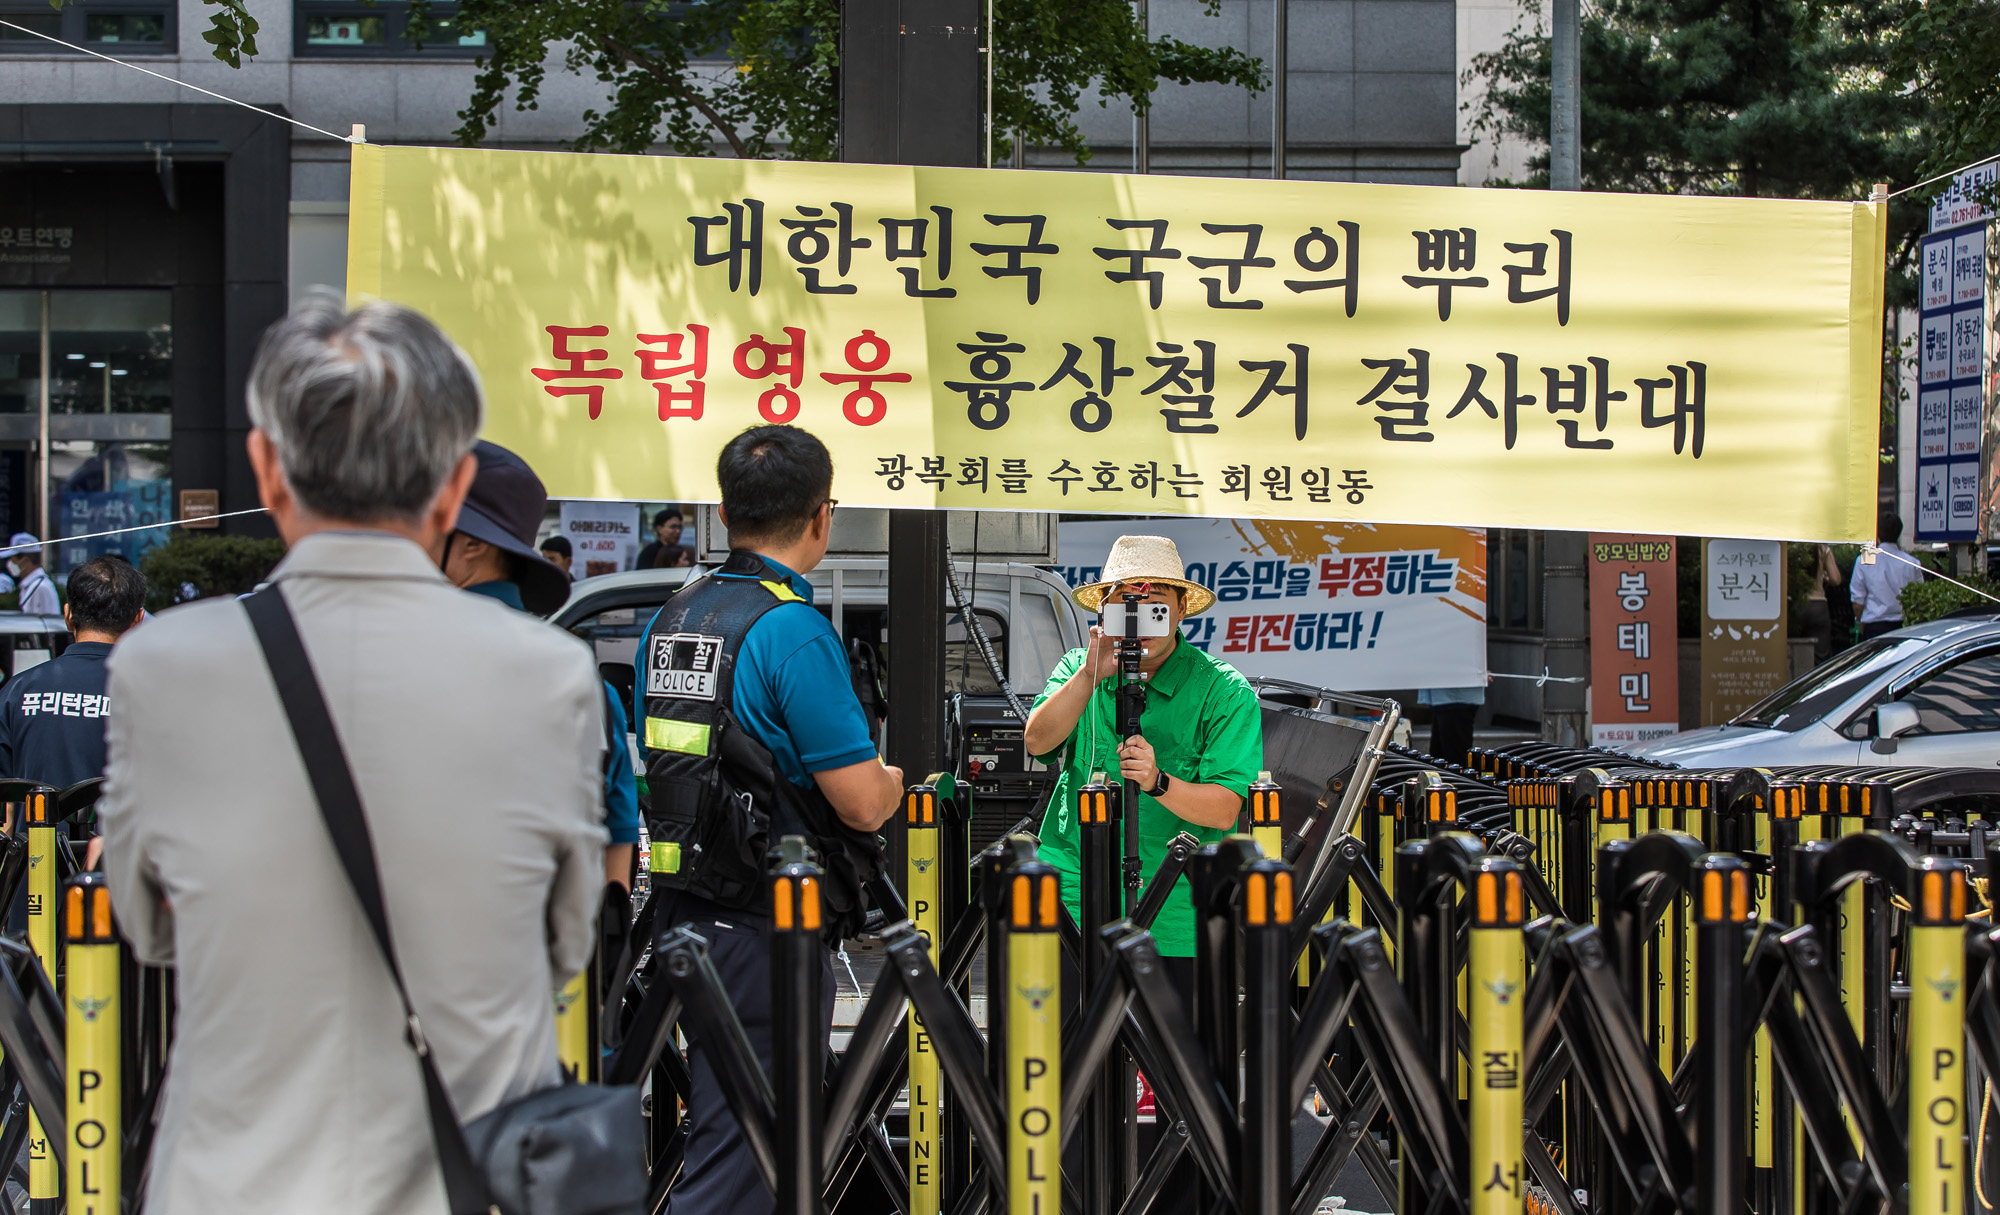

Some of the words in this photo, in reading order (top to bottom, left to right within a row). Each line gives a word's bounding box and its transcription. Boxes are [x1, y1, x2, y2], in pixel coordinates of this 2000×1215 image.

[686, 198, 1060, 306] 대한민국
[1092, 218, 1360, 319] 국군의
[1401, 227, 1573, 327] 뿌리
[1927, 246, 1948, 275] 분식
[1955, 316, 1981, 347] 정동각
[530, 323, 913, 426] 독립영웅
[943, 331, 1310, 441] 흉상철거
[1356, 348, 1707, 460] 결사반대
[874, 454, 1033, 494] 광복회를
[1047, 459, 1204, 499] 수호하는
[1219, 464, 1374, 505] 회원일동
[570, 520, 631, 534] 아메리카노
[1593, 541, 1672, 563] 장모님밥상
[1716, 552, 1773, 567] 스카우트
[1185, 559, 1311, 602] 이승만을
[1317, 553, 1455, 599] 부정하는
[1717, 572, 1769, 602] 분식
[657, 642, 712, 670] 경찰
[1616, 571, 1651, 713] 봉태민
[654, 672, 706, 692] POLICE
[1607, 729, 1634, 741] 토요일
[914, 1085, 930, 1185] LINE
